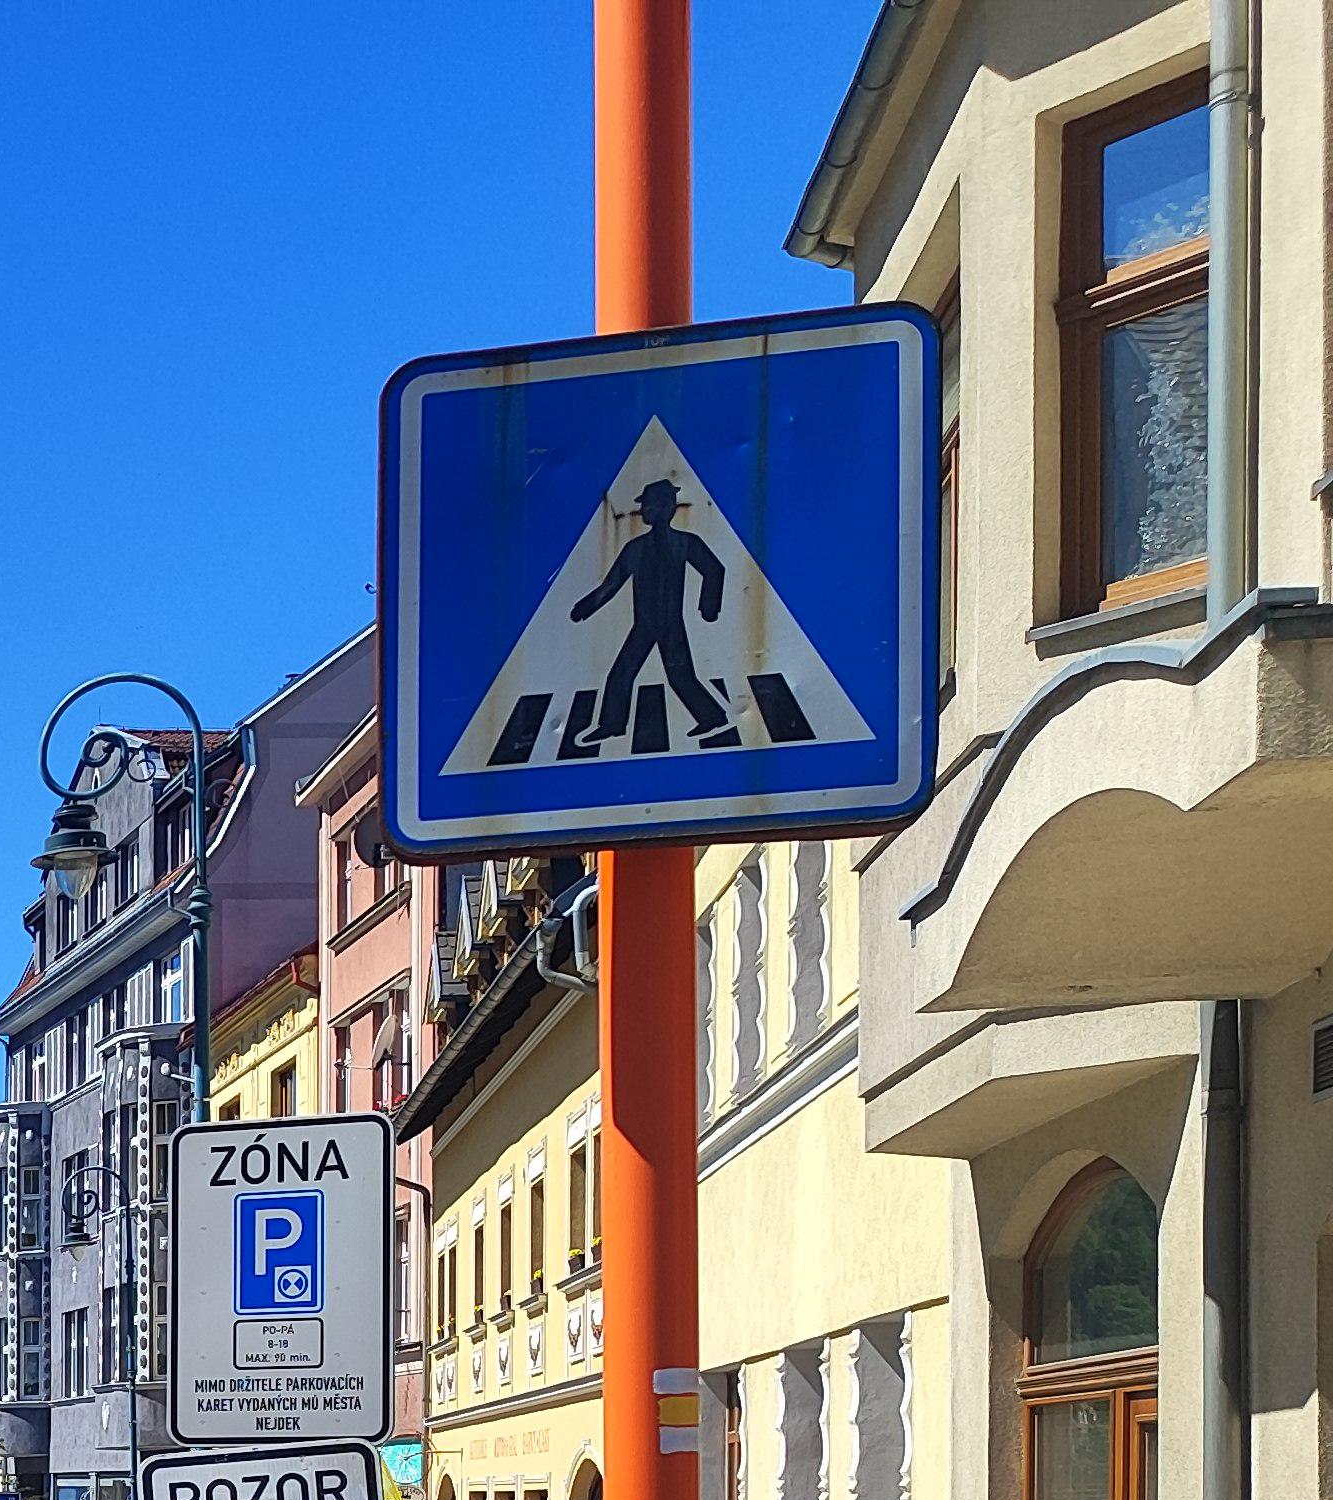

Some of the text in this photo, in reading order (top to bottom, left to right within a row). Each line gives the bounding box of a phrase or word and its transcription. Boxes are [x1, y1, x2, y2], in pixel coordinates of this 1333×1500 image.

[210, 1133, 350, 1187] ZÓNA
[253, 1208, 303, 1276] P
[262, 1324, 294, 1335] PO-PÁ
[268, 1340, 288, 1348] 8-18
[274, 1353, 286, 1362] 90
[290, 1353, 311, 1362] min.
[195, 1374, 364, 1393] MIMO DRŽITELE PARKOVACÍCH
[197, 1399, 234, 1412] KARET
[238, 1395, 297, 1411] VYDANÝCH
[323, 1394, 362, 1411] MĚSTA
[255, 1417, 301, 1430] NEJDEK
